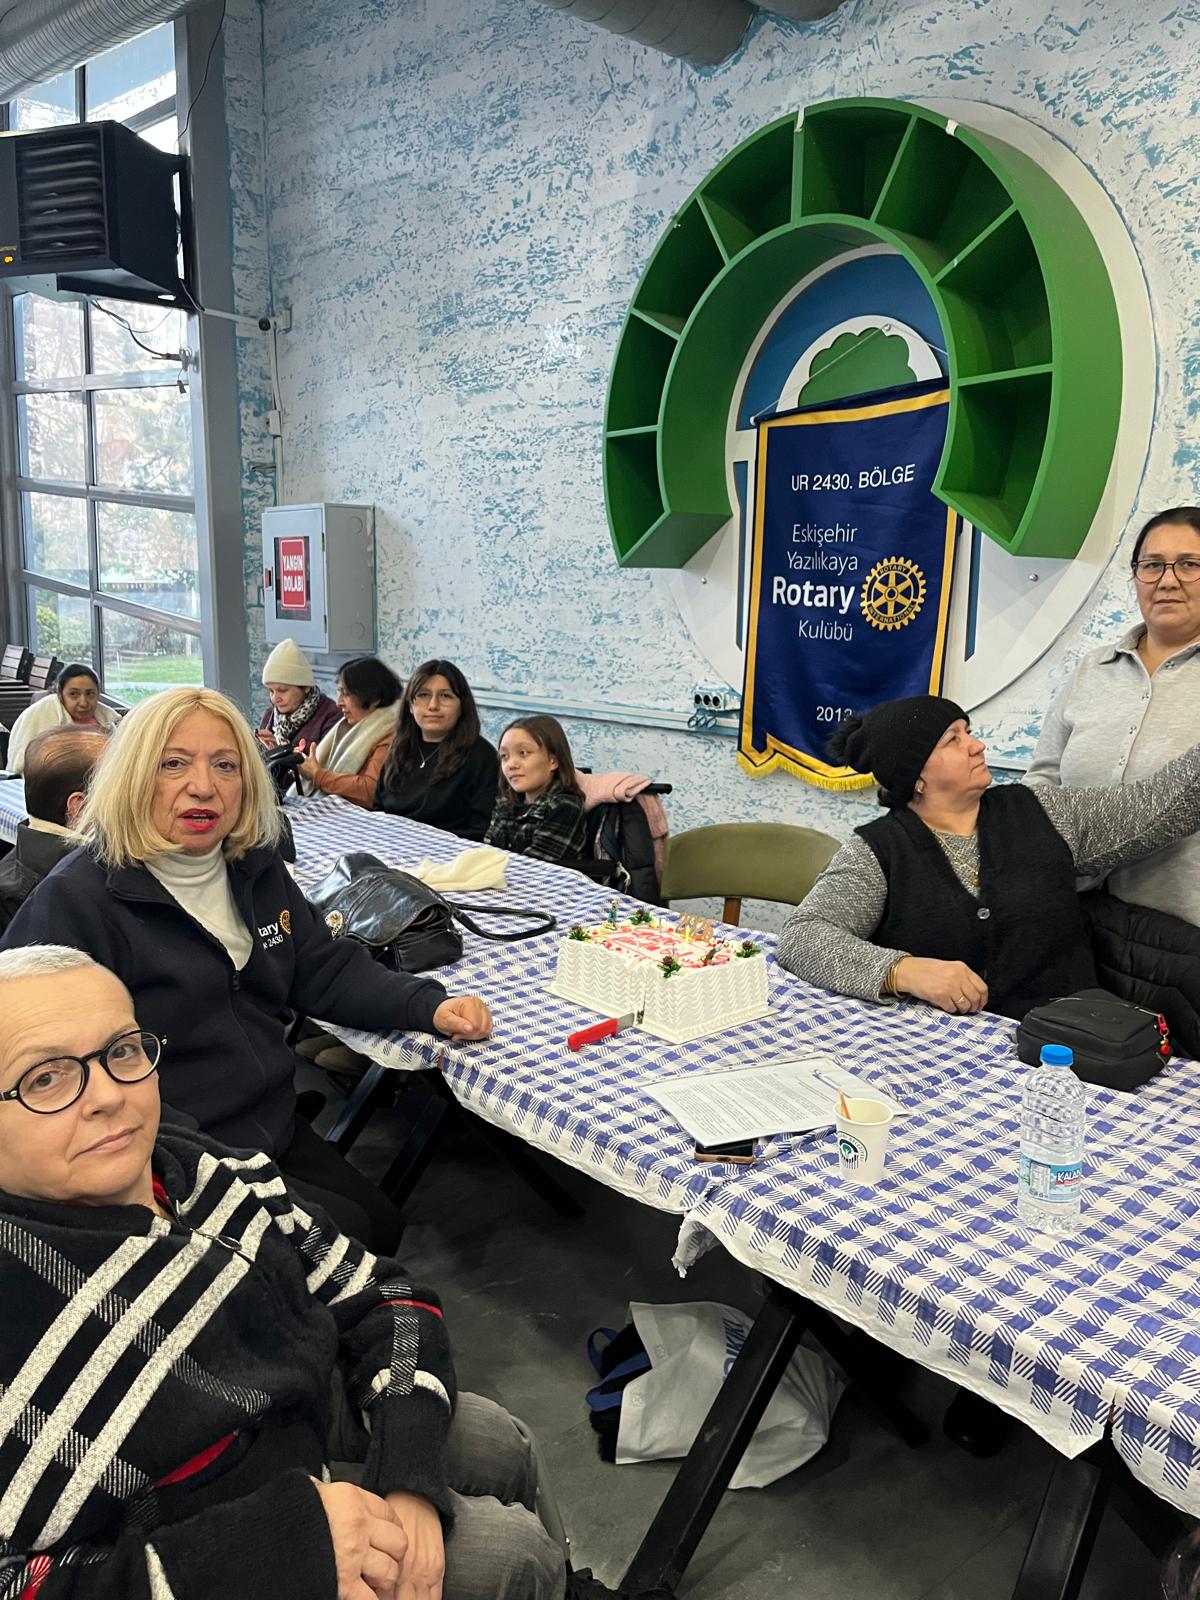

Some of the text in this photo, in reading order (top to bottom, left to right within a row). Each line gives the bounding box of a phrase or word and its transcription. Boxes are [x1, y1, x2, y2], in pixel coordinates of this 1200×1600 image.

[791, 463, 916, 491] UR 2430. BÖLGE
[792, 522, 858, 548] Eskişehir
[282, 554, 304, 571] YANGIN
[786, 550, 858, 576] Yazılıkaya
[880, 565, 908, 575] ROTARY
[283, 575, 304, 592] DOLABI
[772, 575, 856, 614] Rotary
[868, 603, 916, 624] INTERNATIONAL
[798, 619, 854, 641] Kulübü
[267, 934, 284, 948] 2430
